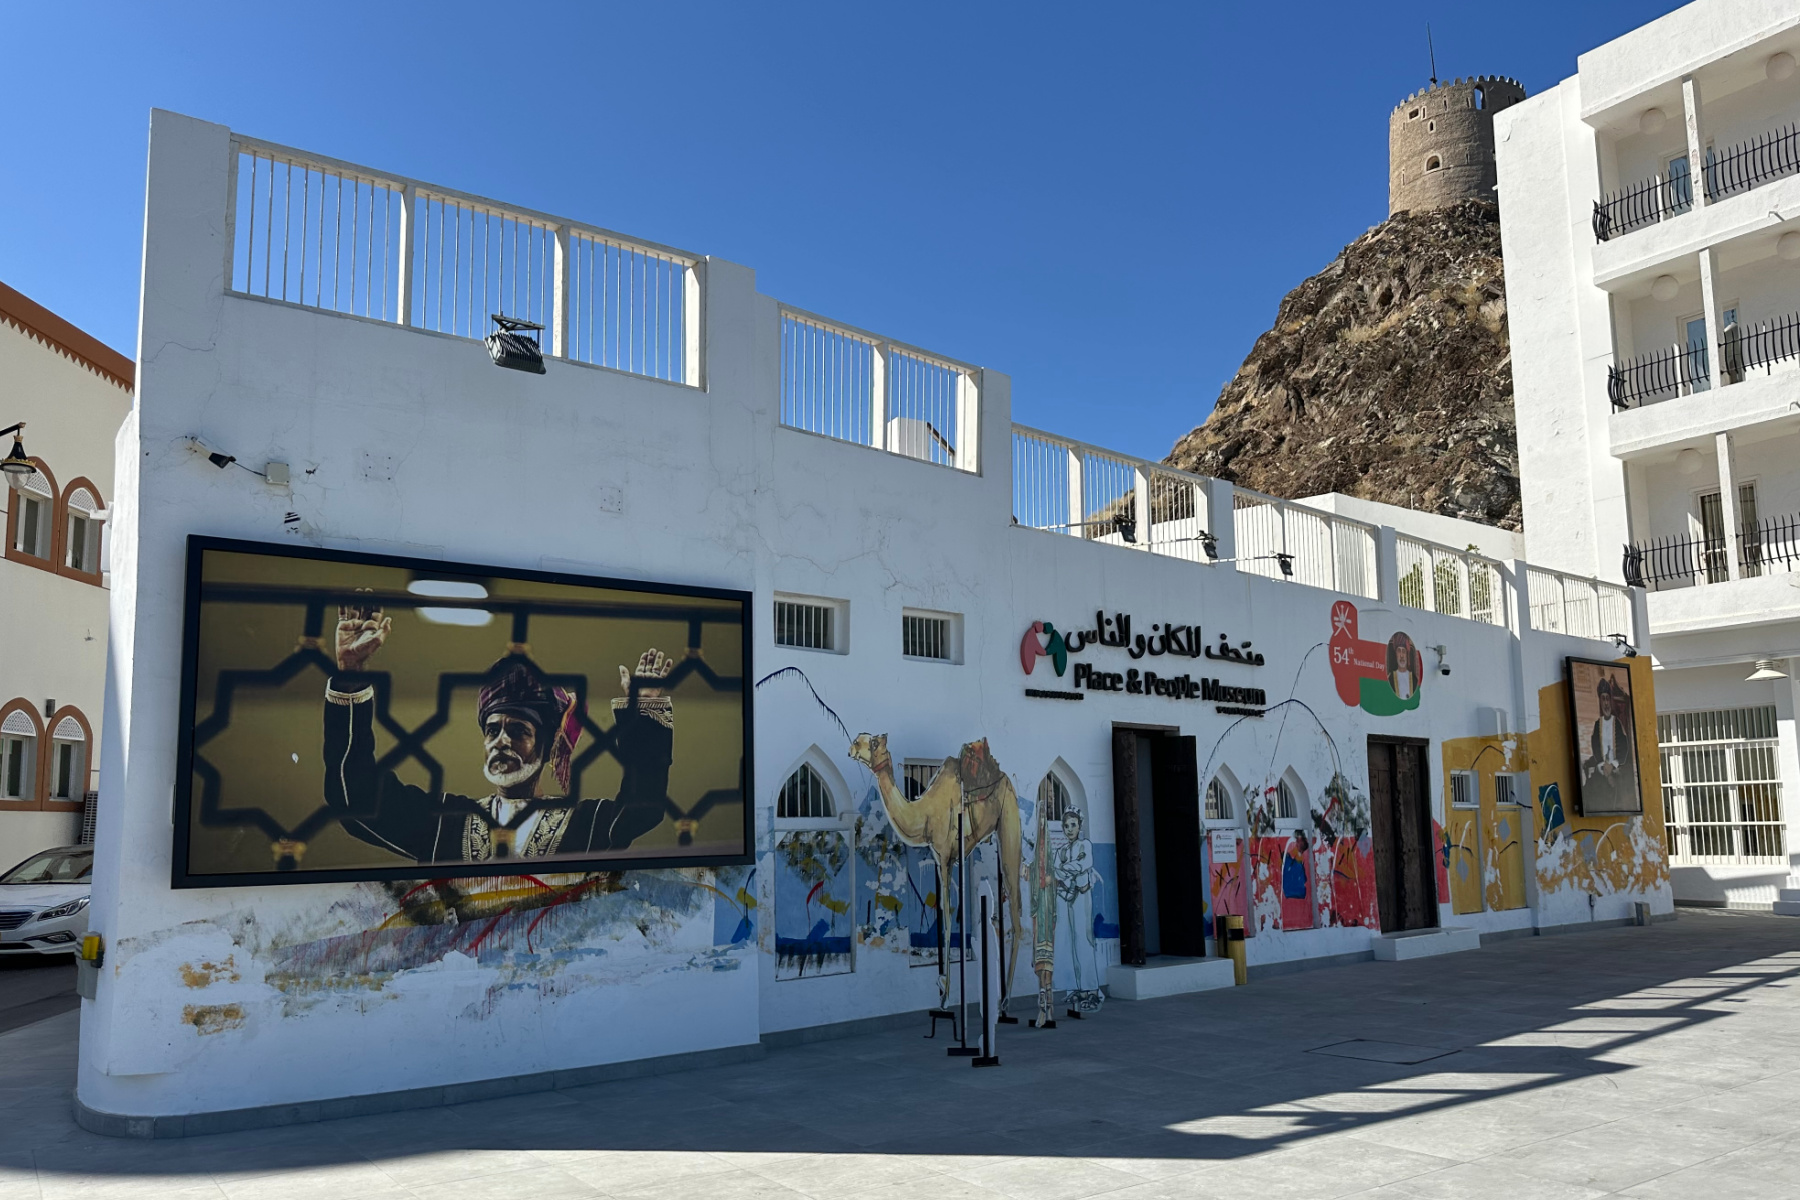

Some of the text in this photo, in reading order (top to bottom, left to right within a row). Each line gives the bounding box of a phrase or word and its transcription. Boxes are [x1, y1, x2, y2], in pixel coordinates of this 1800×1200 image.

[1205, 633, 1265, 666] متحف
[1333, 647, 1385, 671] 54th National Day
[1074, 663, 1266, 705] Place & People Museum
